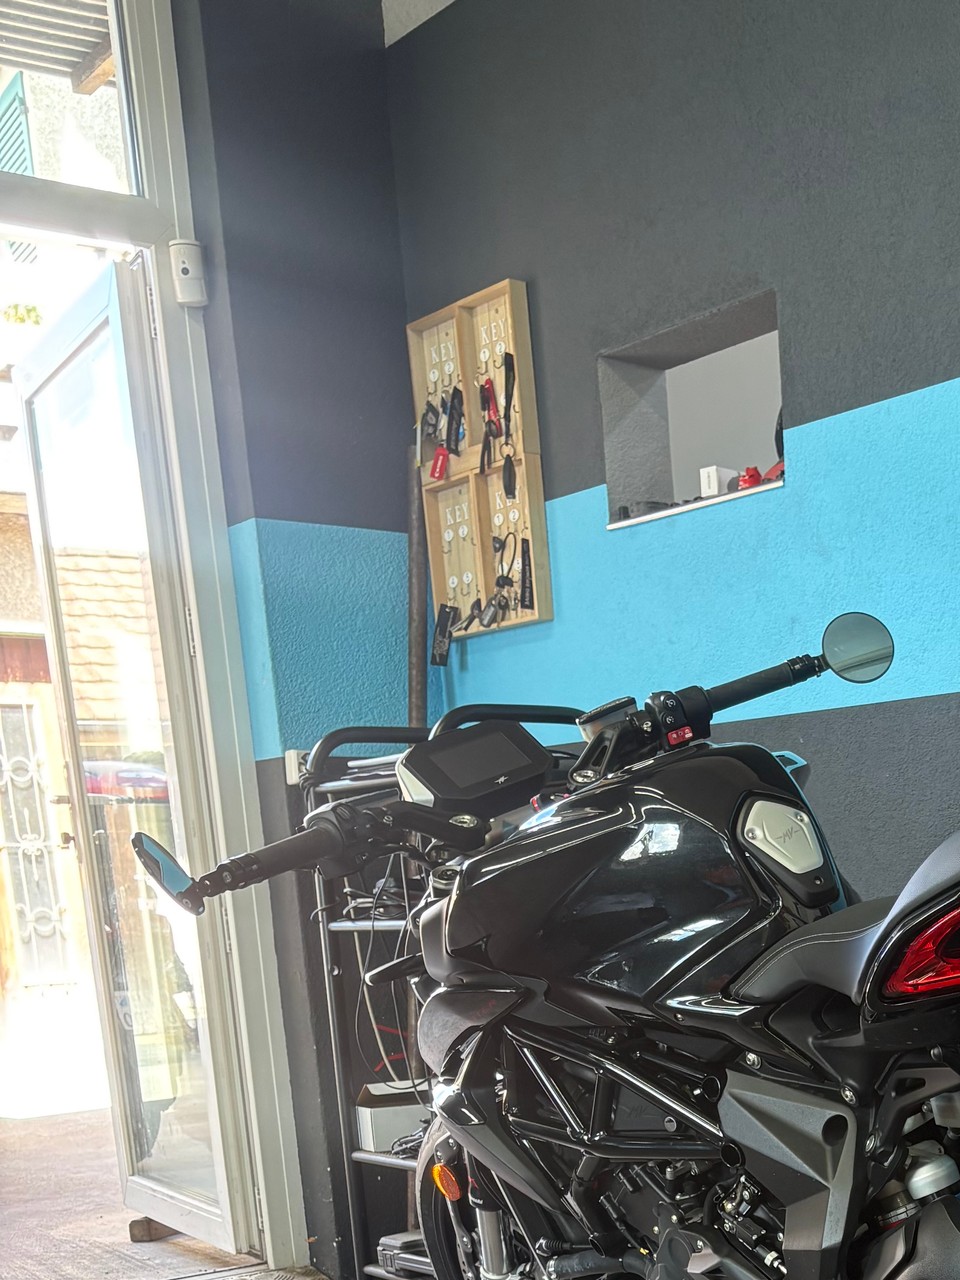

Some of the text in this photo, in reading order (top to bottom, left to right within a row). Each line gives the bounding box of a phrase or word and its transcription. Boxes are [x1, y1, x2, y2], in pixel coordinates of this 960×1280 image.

[481, 319, 506, 345] KEY
[430, 341, 455, 364] KEY
[446, 502, 469, 525] KEY
